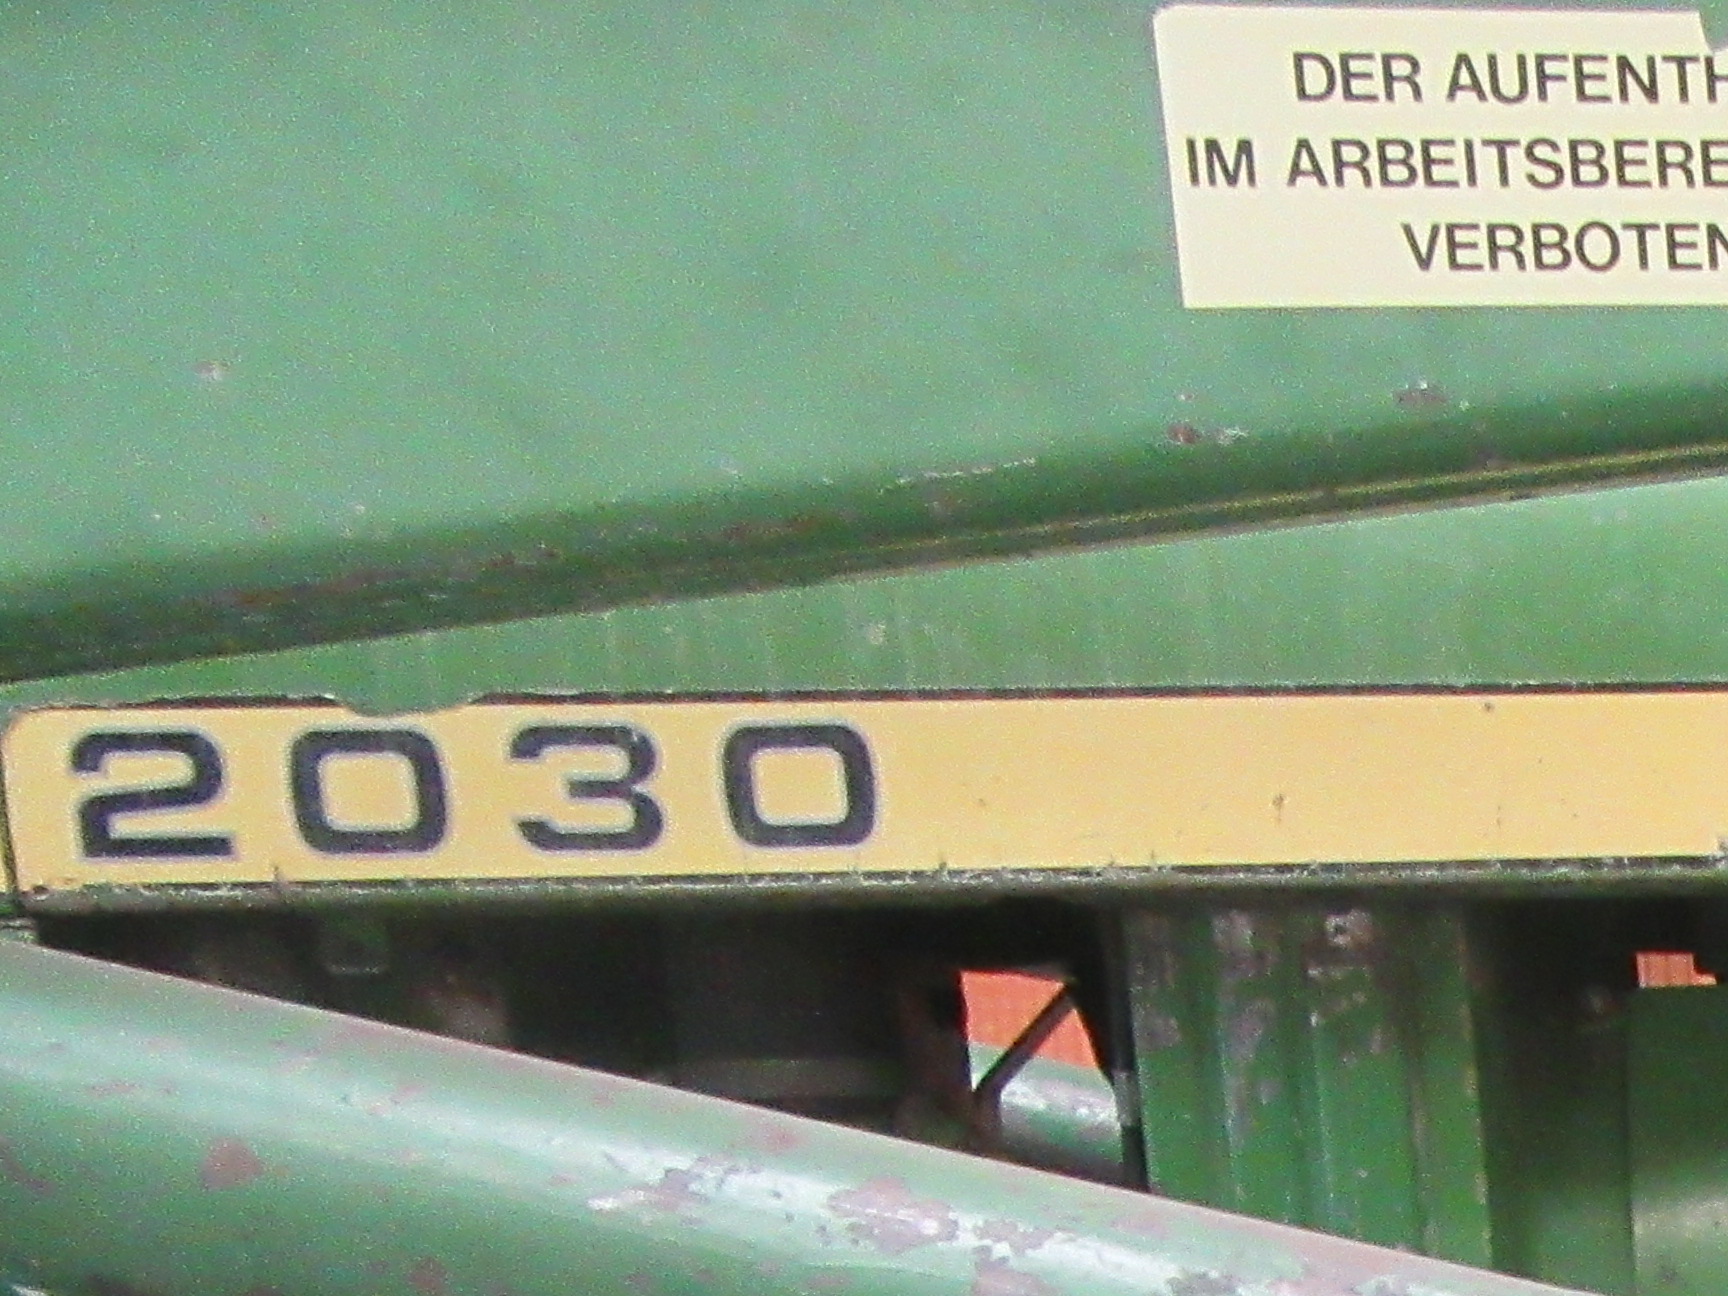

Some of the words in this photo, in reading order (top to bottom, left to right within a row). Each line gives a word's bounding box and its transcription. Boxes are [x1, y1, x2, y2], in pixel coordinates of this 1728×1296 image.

[1293, 52, 1423, 101] DER
[1186, 138, 1257, 186] IM
[69, 723, 876, 859] 2030
